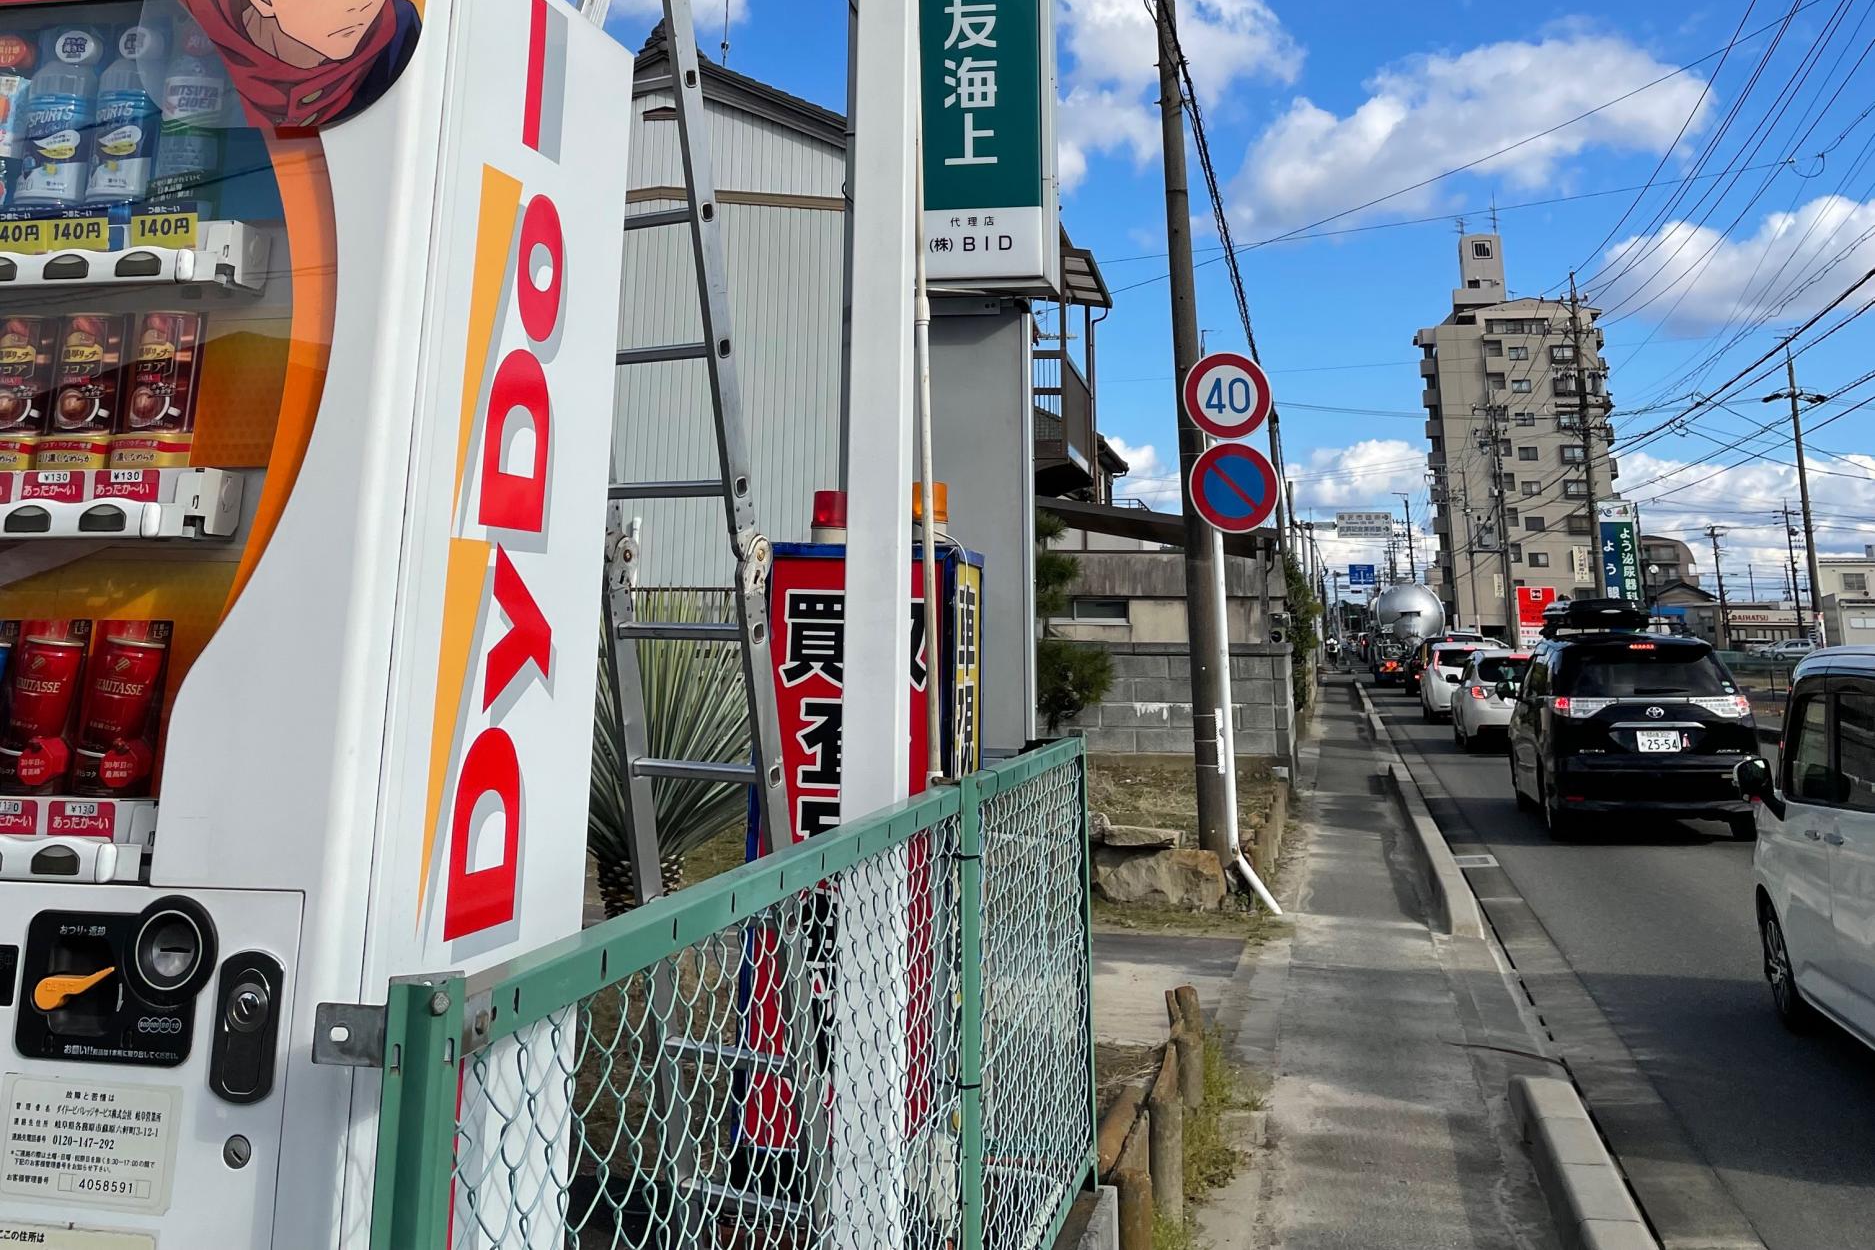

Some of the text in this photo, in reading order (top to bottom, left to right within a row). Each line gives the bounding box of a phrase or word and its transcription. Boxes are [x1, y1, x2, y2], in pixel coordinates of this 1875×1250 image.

[140, 217, 190, 238] 140円
[950, 216, 994, 228] 代理店
[54, 222, 101, 241] 140円
[1206, 377, 1251, 414] 40
[44, 473, 68, 481] ¥130
[114, 472, 139, 480] ¥130
[1647, 738, 1678, 750] 25-54
[53, 1135, 115, 1150] 0120-147-292
[79, 1178, 134, 1194] 4058591
